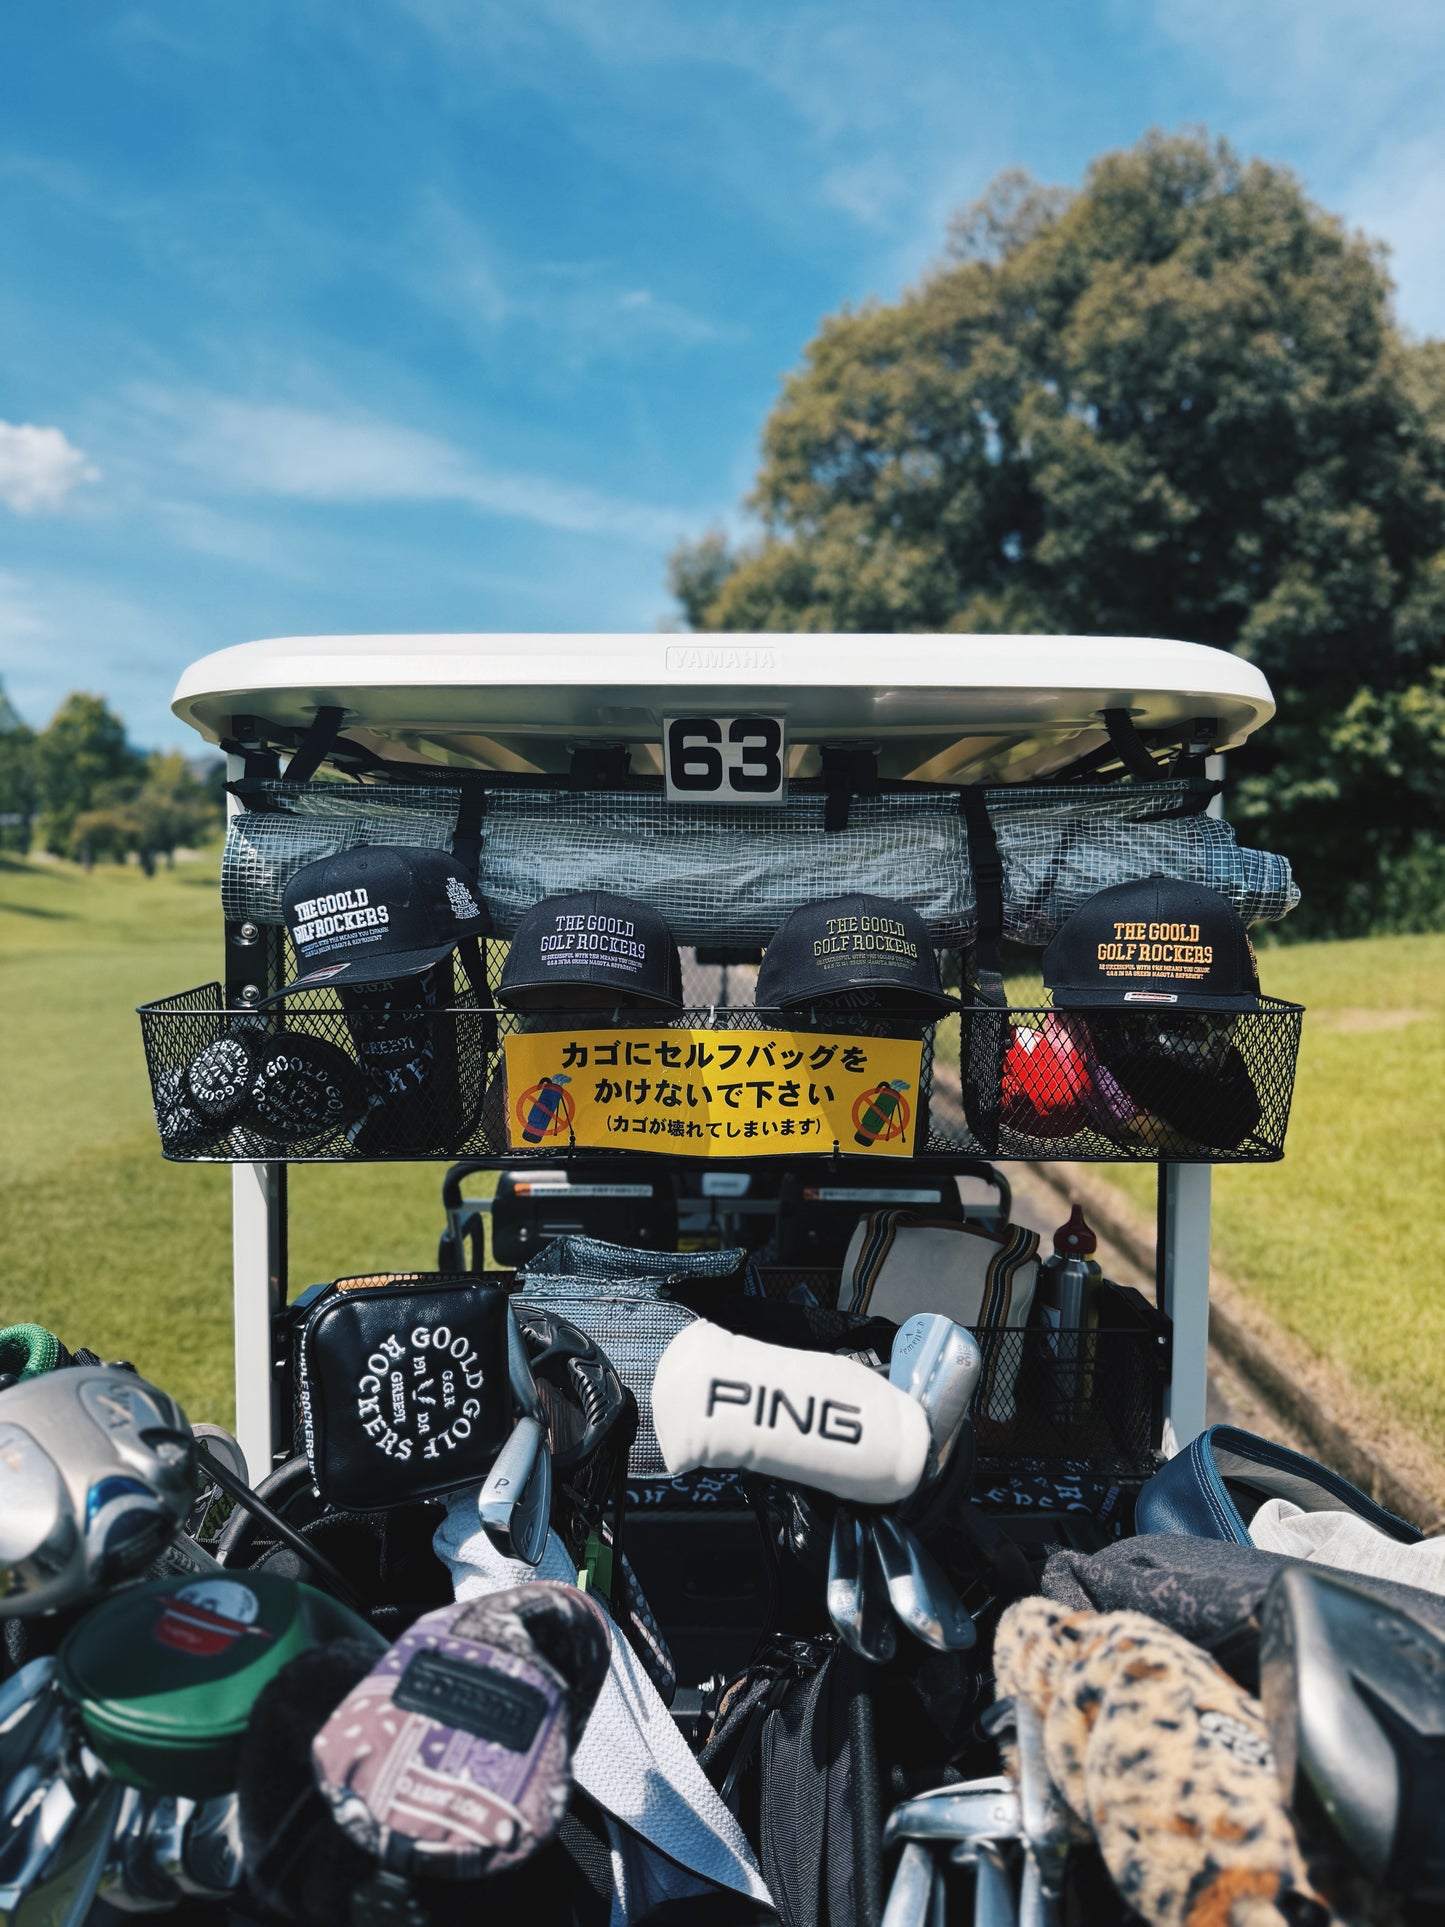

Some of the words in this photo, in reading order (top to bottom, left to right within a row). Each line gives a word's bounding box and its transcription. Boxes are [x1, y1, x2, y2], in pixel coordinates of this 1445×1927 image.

[675, 650, 776, 669] YAMAHA
[668, 718, 782, 793] 63
[294, 899, 319, 922] THE
[316, 888, 369, 916] GOOLD
[314, 905, 390, 938] ROCKERS
[556, 915, 586, 932] THE
[587, 915, 635, 937] GOOLD
[826, 916, 858, 935] THE
[861, 916, 905, 937] GOOLD
[1113, 922, 1147, 940] THE
[1148, 922, 1200, 943] GOOLD
[540, 934, 576, 952] GOLF
[576, 934, 646, 960] ROCKERS
[813, 935, 850, 957] GOLF
[852, 934, 918, 958] ROCKERS
[1097, 943, 1137, 961] GOLF
[1138, 943, 1213, 964] ROCKERS
[561, 1040, 869, 1074] カゴにセルフバッグを
[594, 1078, 836, 1109] かけないで下さい
[606, 1115, 823, 1138] (カゴが壊れてしまいます)
[411, 1326, 484, 1389] GOOLD
[358, 1334, 414, 1460] ROCKERS
[390, 1371, 407, 1425] GREEN
[705, 1377, 864, 1445] PING
[302, 1390, 315, 1459] ROCKERS
[423, 1398, 481, 1459] GOLF
[494, 1477, 510, 1490] P
